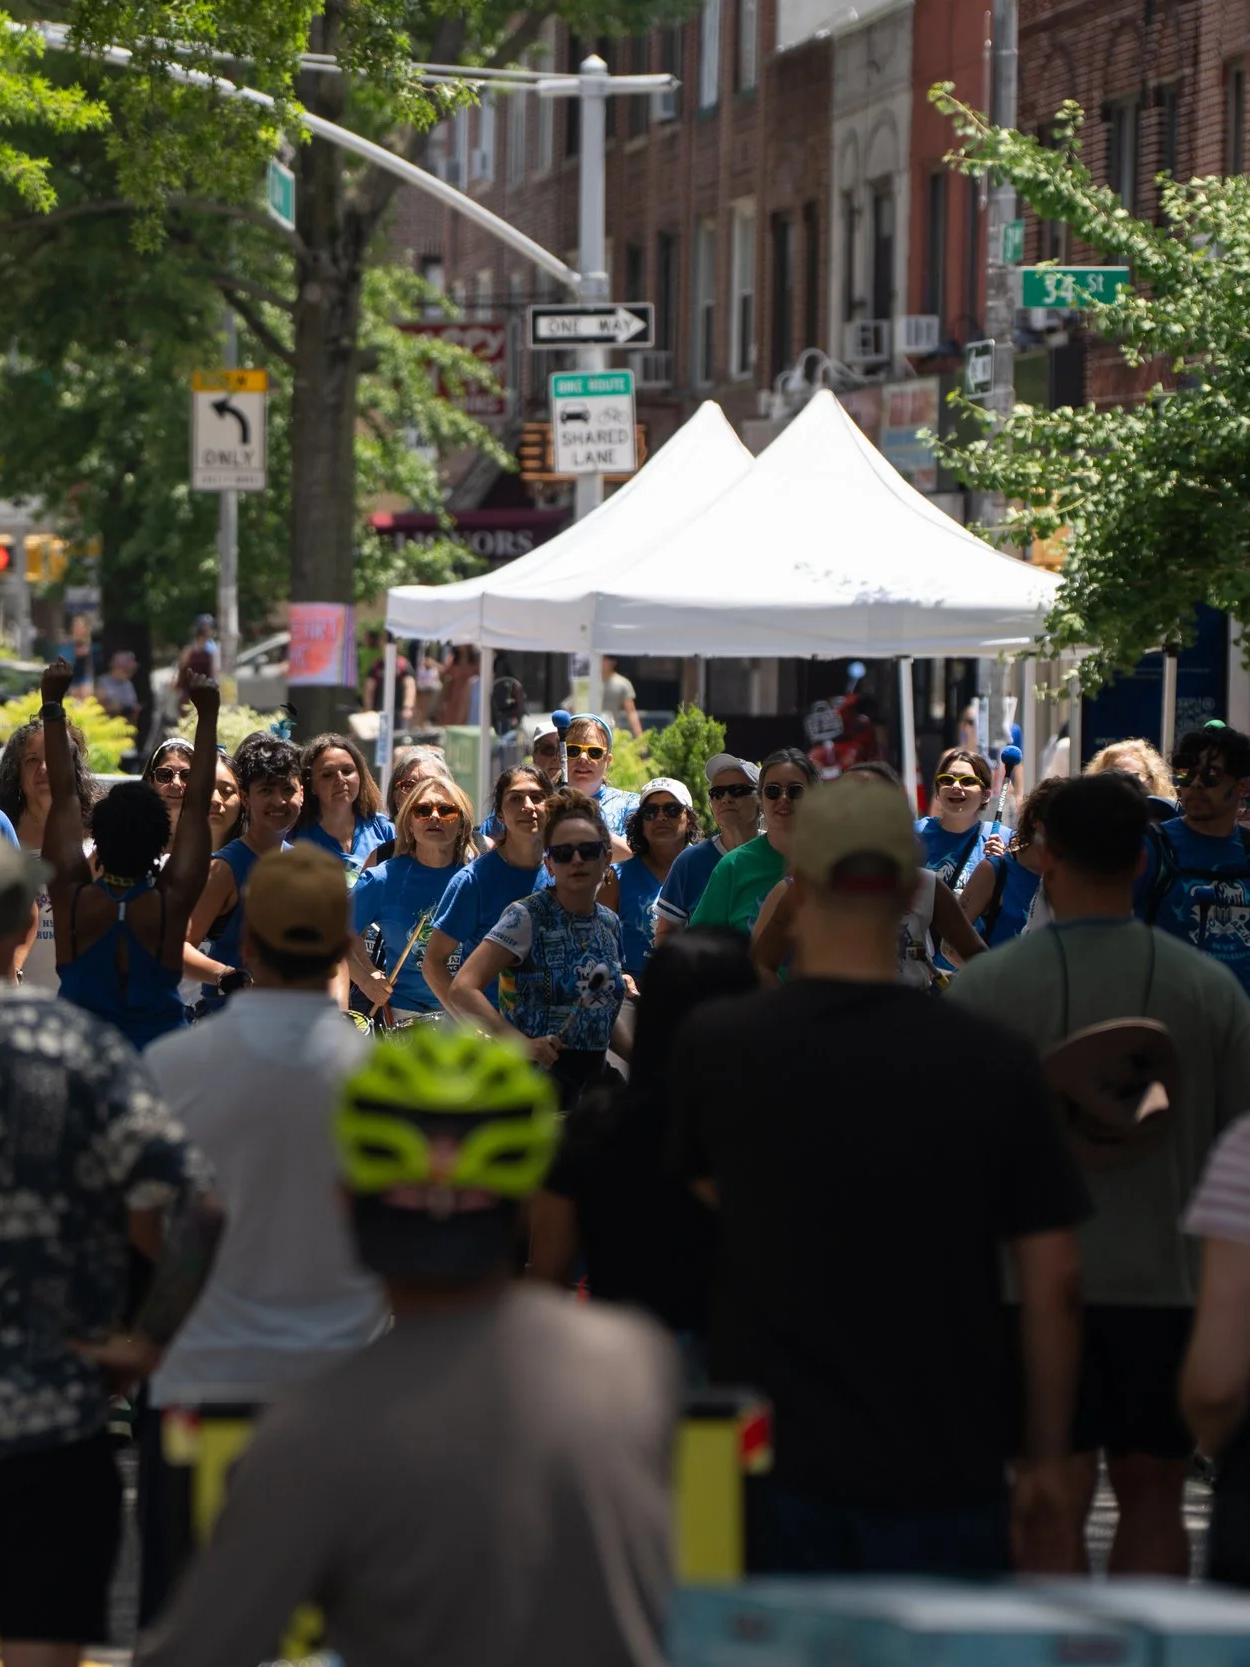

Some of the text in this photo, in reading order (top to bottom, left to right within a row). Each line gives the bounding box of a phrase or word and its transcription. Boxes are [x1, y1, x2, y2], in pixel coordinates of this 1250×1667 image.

[1042, 273, 1105, 305] 34 St
[549, 317, 632, 333] ONE WAY
[557, 377, 626, 393] BIKE ROUTE
[561, 429, 629, 446] SHARED
[203, 448, 256, 468] ONLY
[573, 448, 617, 467] LANE
